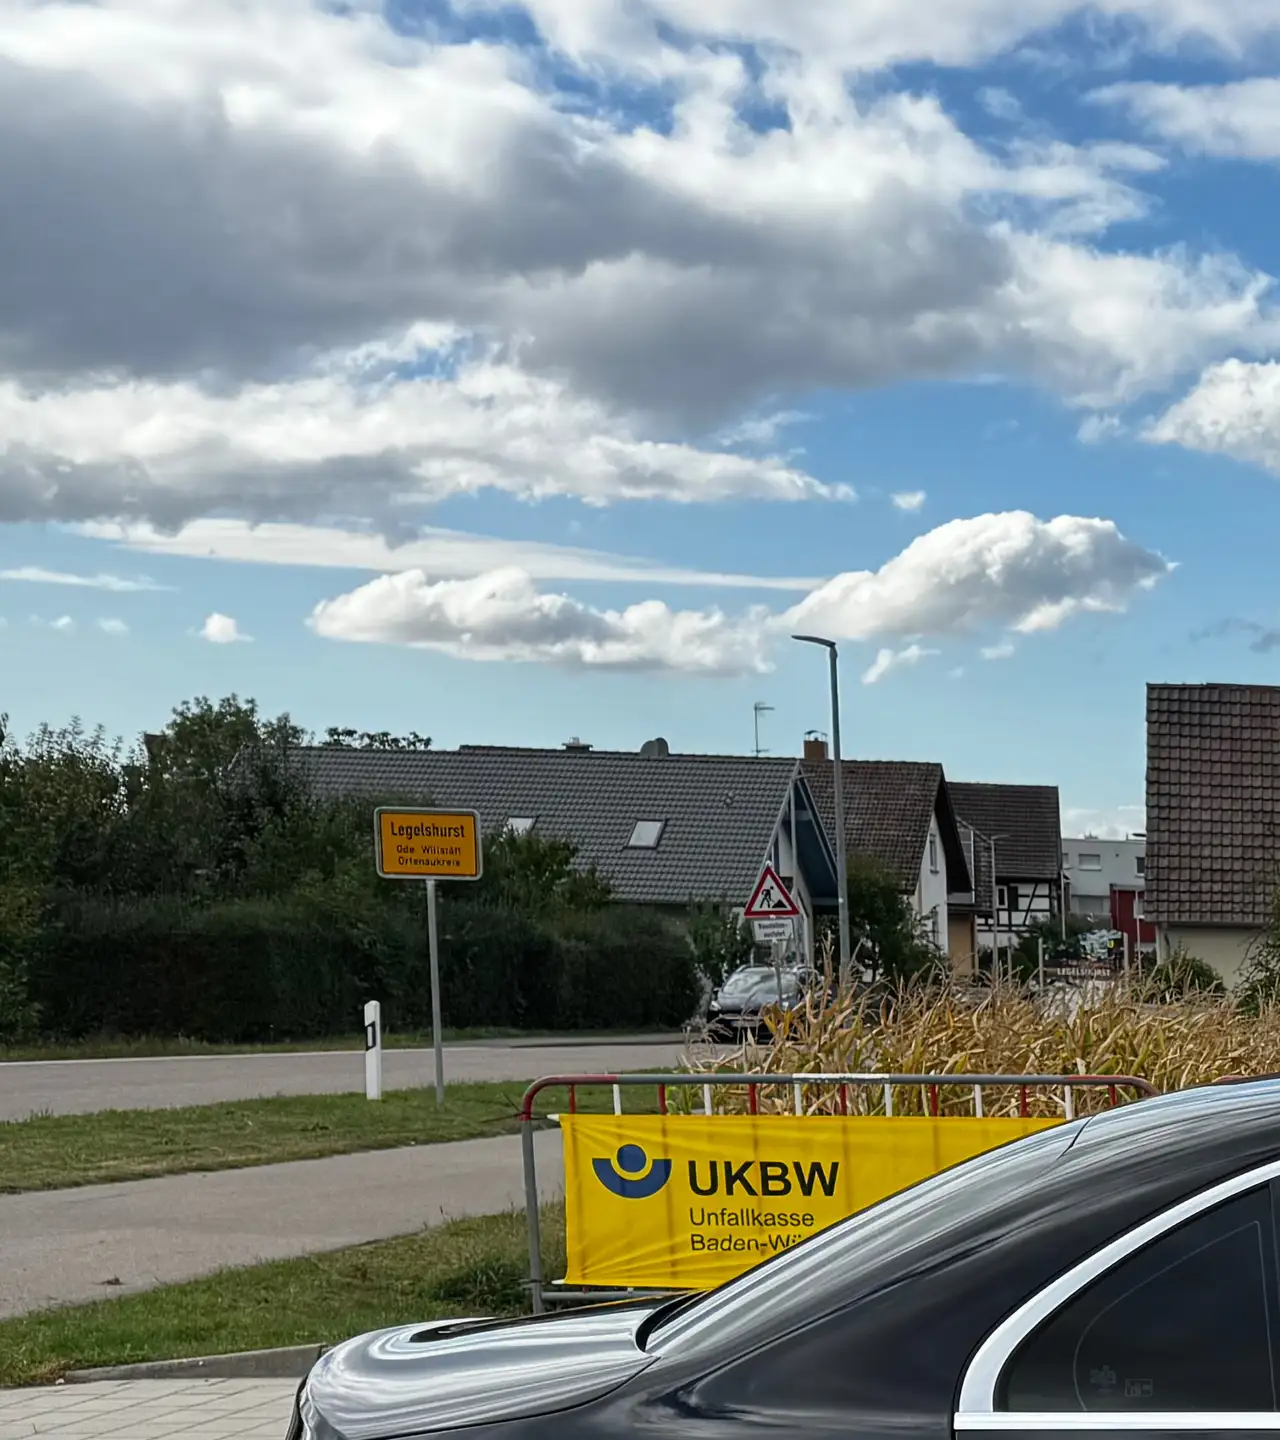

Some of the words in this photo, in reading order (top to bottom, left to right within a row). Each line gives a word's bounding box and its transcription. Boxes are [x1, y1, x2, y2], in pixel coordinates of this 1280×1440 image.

[390, 821, 466, 840] Legelshurst
[687, 1160, 840, 1197] UKBW
[689, 1207, 815, 1227] Unfallkasse
[690, 1233, 801, 1251] Baden-W
